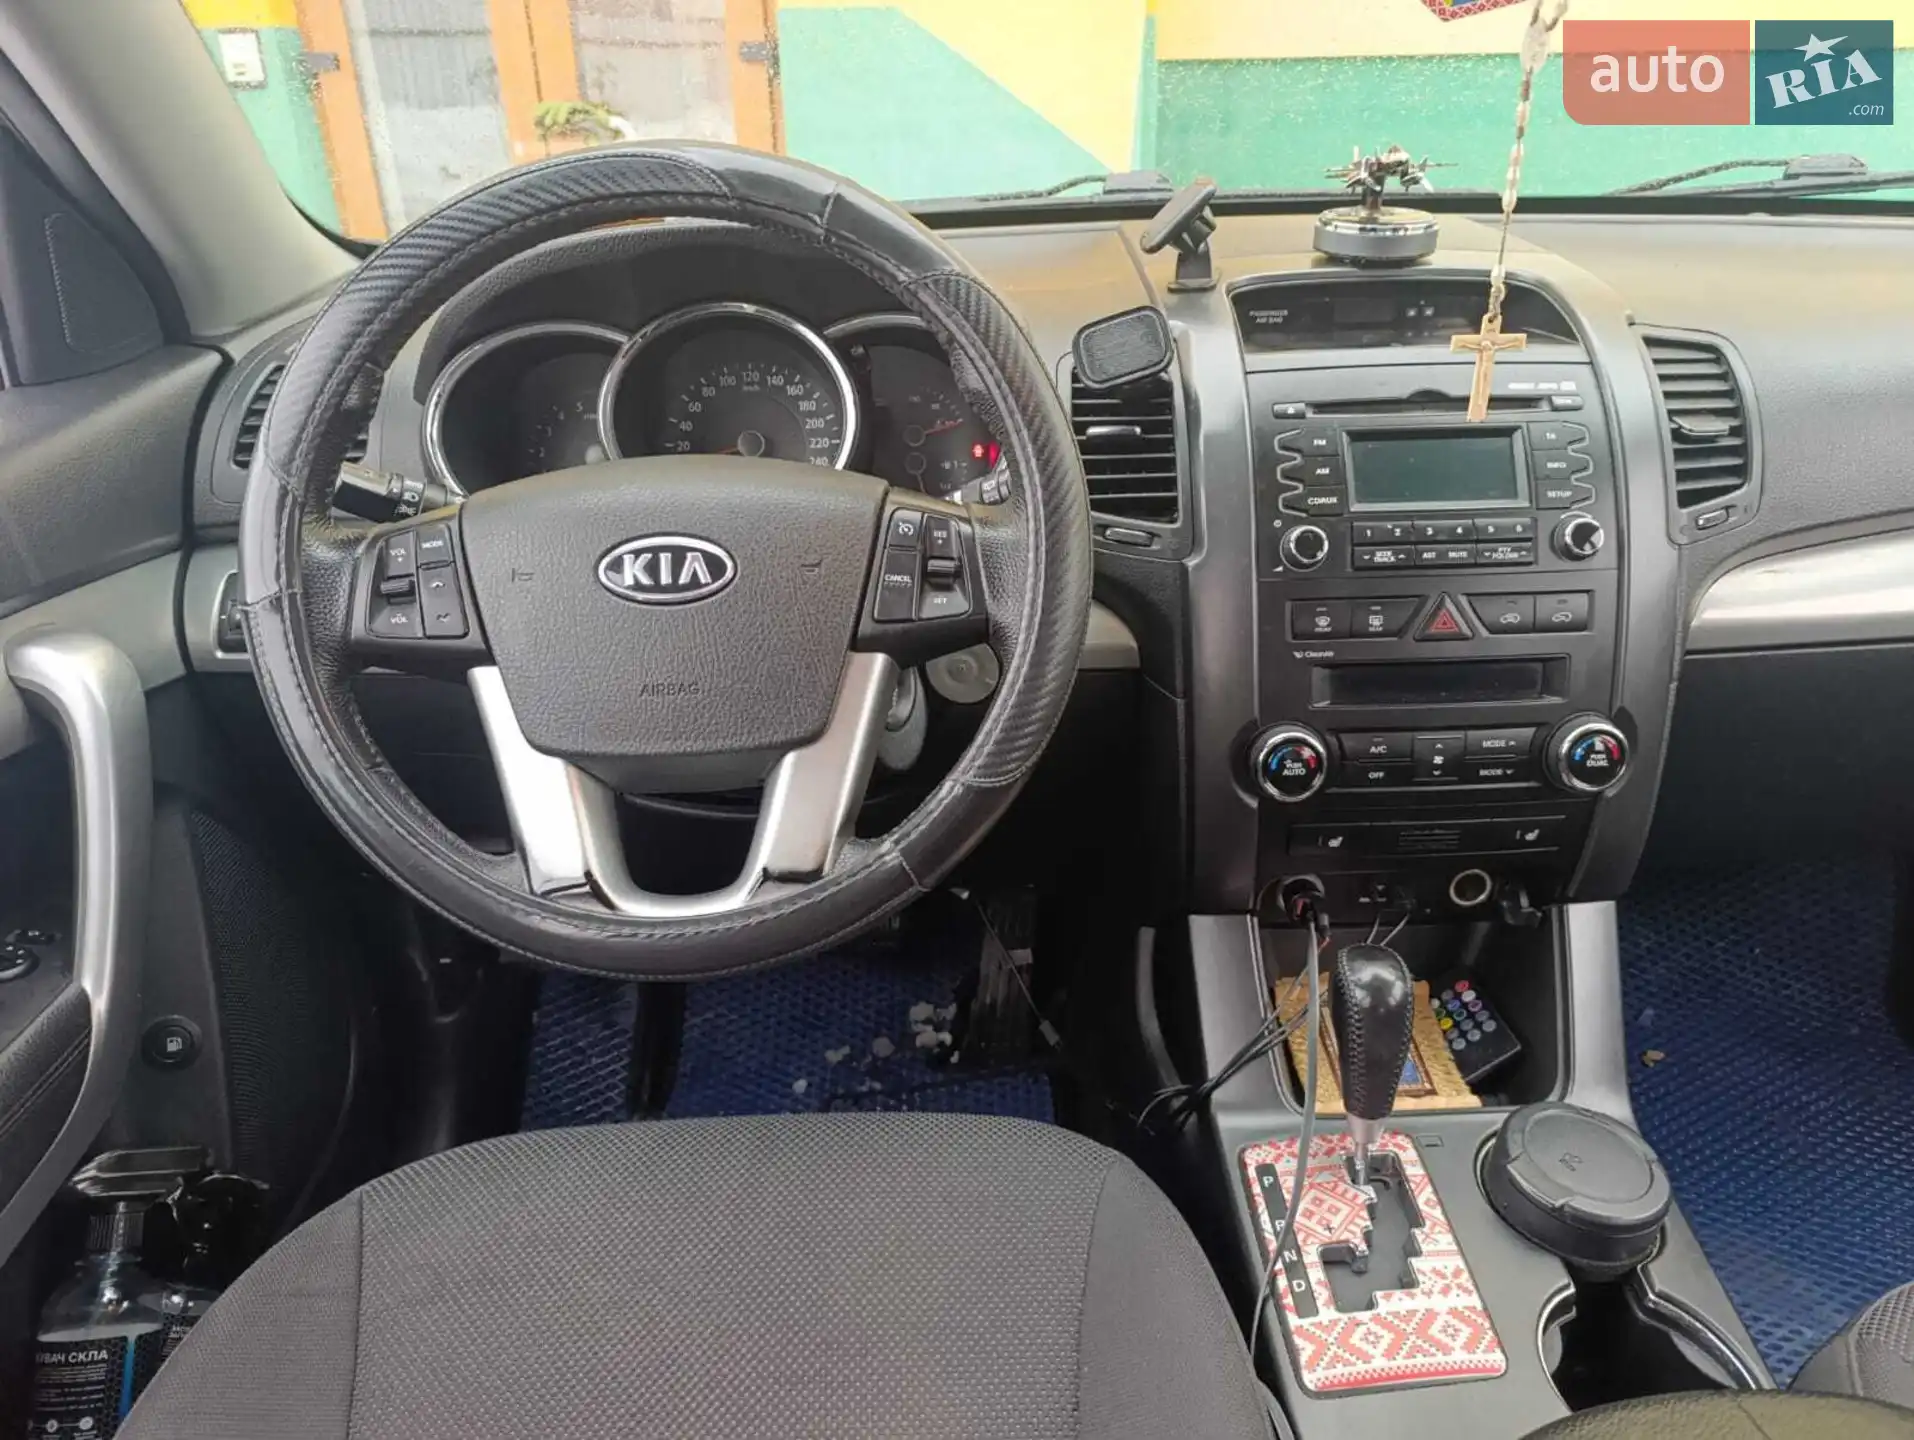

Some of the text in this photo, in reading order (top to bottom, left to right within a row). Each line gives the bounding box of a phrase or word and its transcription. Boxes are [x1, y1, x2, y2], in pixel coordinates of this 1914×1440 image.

[719, 374, 737, 387] 100
[742, 371, 760, 382] 120
[766, 375, 784, 387] 140
[702, 387, 716, 397] 80
[786, 385, 804, 396] 160
[688, 402, 702, 413] 60
[799, 400, 817, 412] 180
[679, 421, 693, 432] 40
[805, 418, 825, 430] 200
[676, 441, 691, 451] 20
[809, 438, 830, 448] 220
[1366, 529, 1372, 537] 1
[622, 553, 712, 586] KIA
[884, 574, 912, 583] CANCEL
[639, 682, 700, 698] AIRBAG
[1482, 739, 1507, 748] MODE
[1369, 745, 1388, 754] A/C
[1282, 767, 1306, 776] AUTO
[1368, 771, 1385, 780] OFF
[1262, 1175, 1274, 1188] P
[1283, 1249, 1298, 1264] N
[1292, 1279, 1306, 1293] D
[68, 1349, 109, 1363] СКЛА
